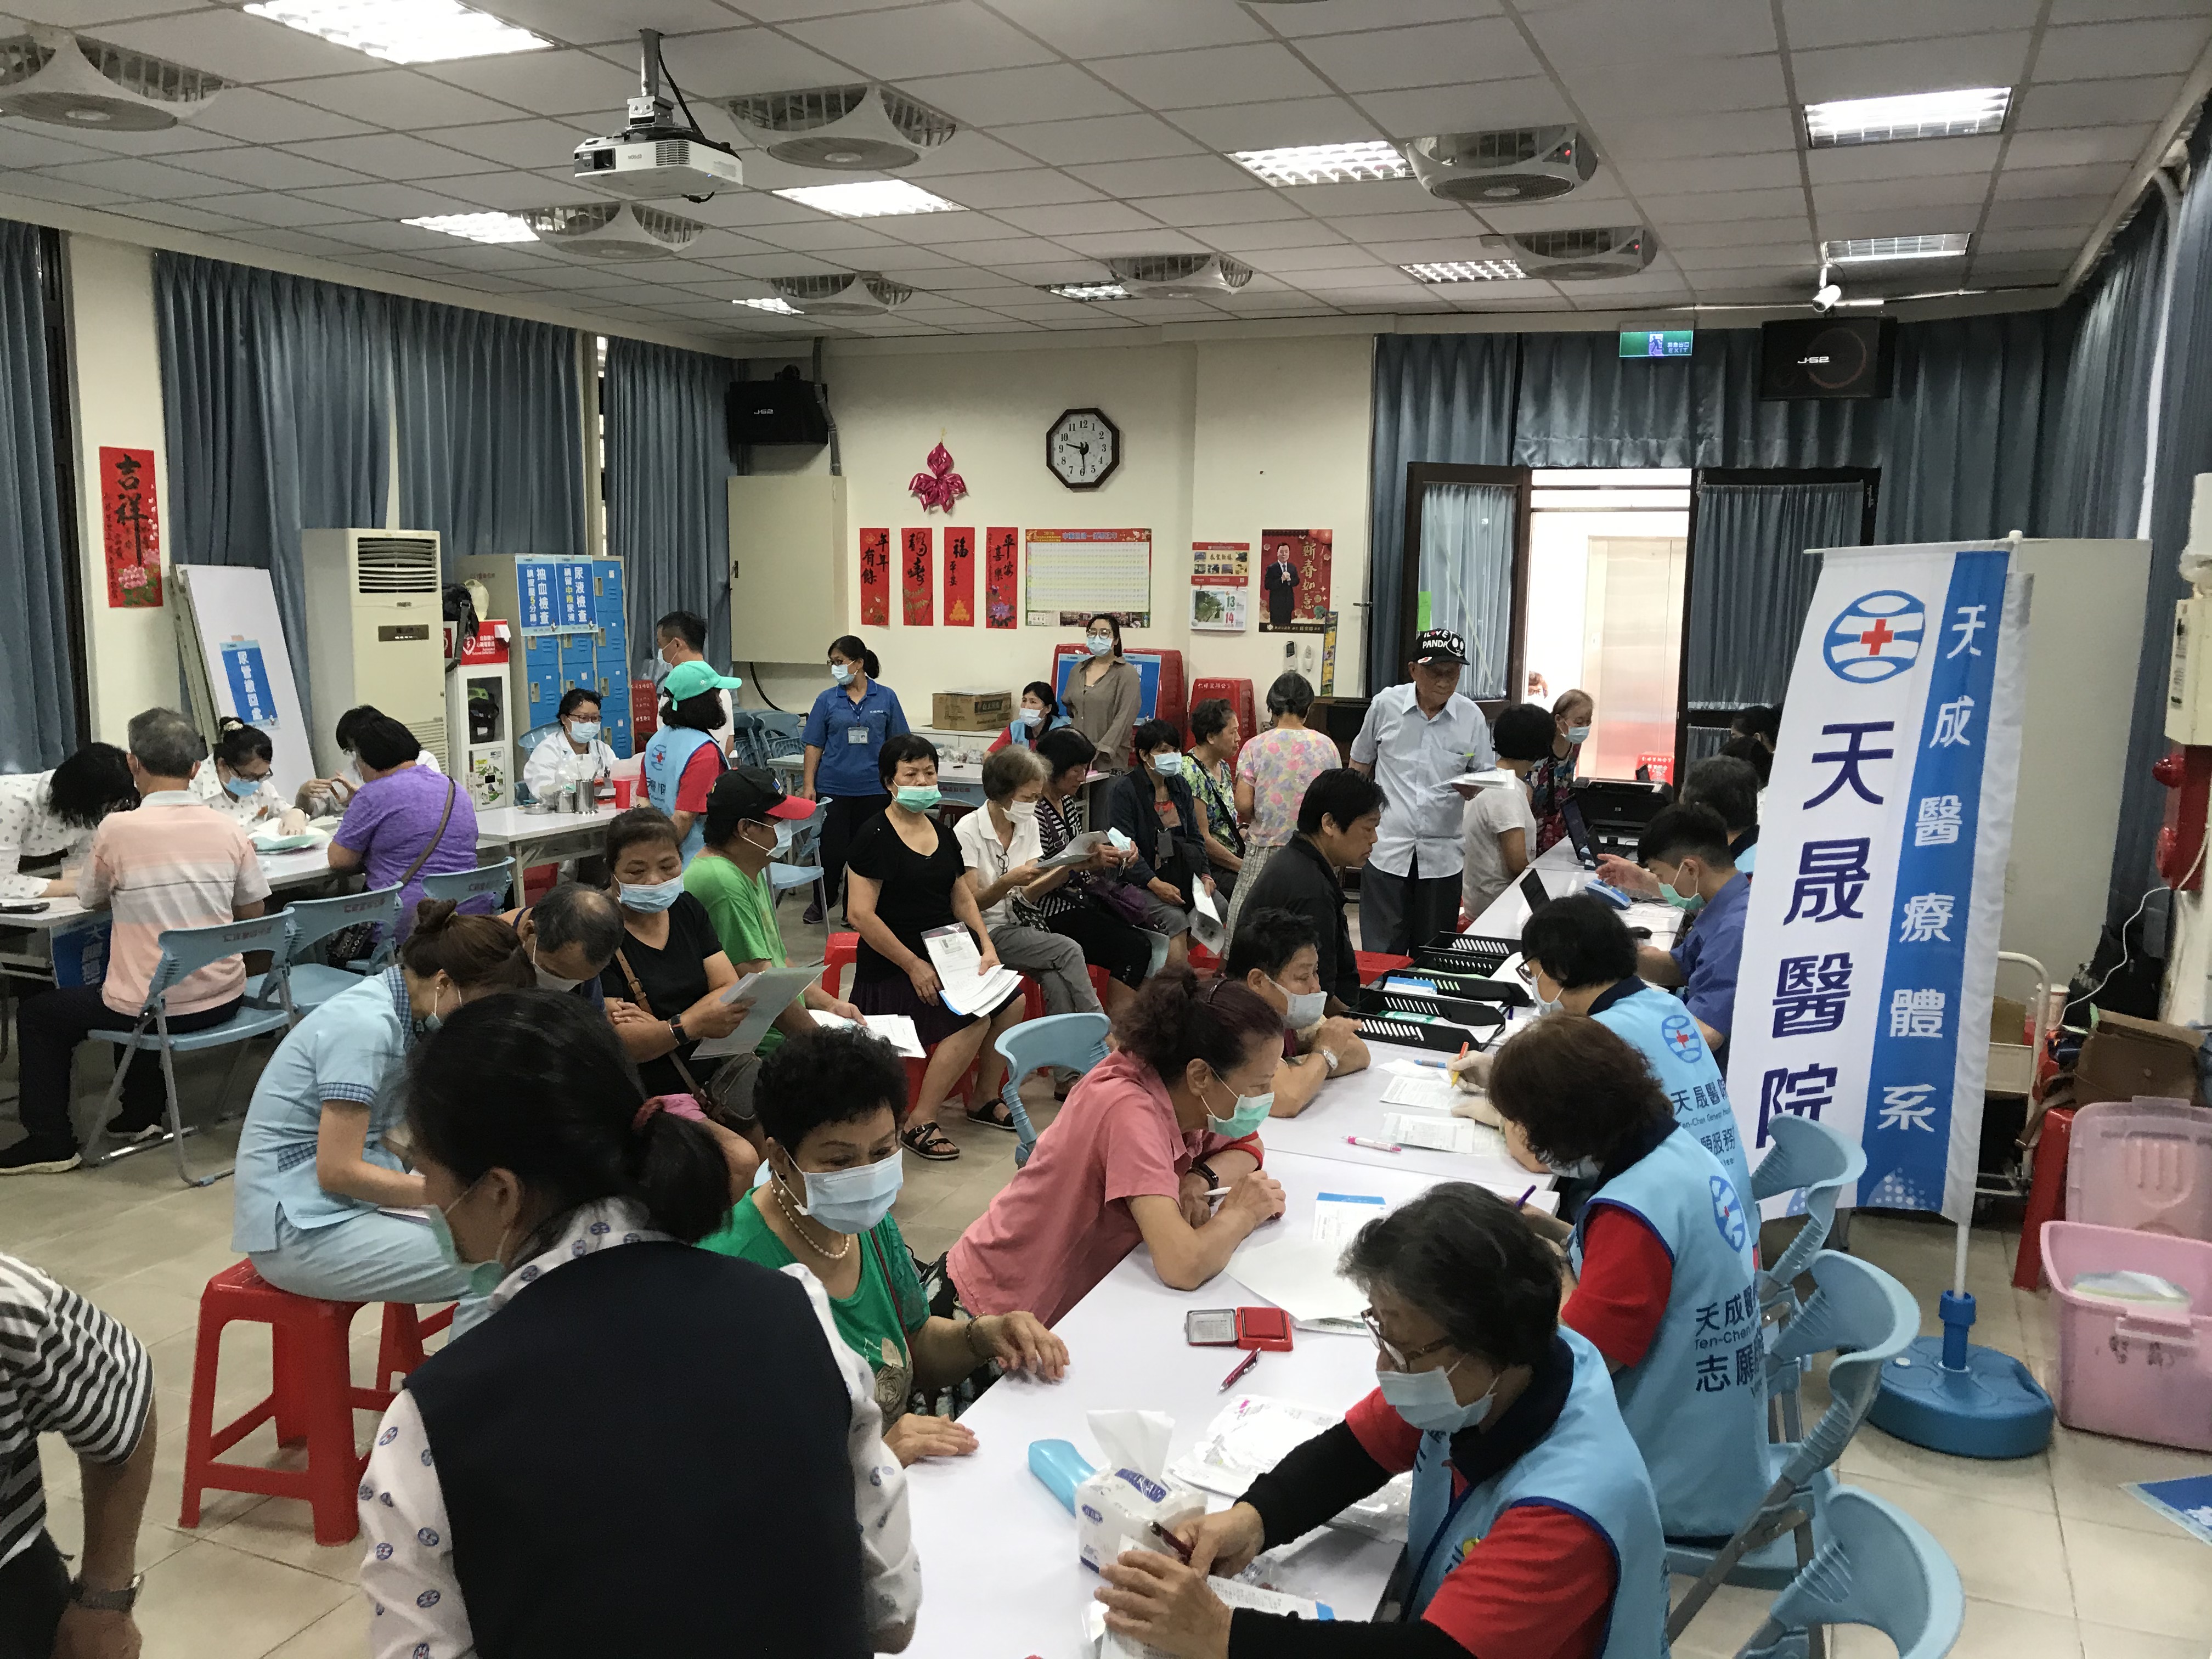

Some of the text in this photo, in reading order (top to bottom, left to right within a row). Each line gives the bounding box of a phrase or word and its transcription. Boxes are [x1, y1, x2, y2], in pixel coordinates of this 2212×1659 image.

[1060, 433, 1068, 441] 10
[1102, 444, 1106, 452] 3
[1061, 456, 1066, 465] 8
[1069, 466, 1073, 474] 7
[1080, 467, 1085, 476] 6
[115, 453, 149, 566] 吉祥
[875, 532, 889, 572] 年年
[953, 536, 969, 558] 福
[1002, 533, 1015, 577] 平安
[861, 546, 877, 585] 有餘
[1300, 541, 1317, 610] 新春如意
[537, 567, 549, 624] 抽血檢查
[574, 567, 587, 622] 尿液檢查
[1227, 596, 1235, 607] 13
[1226, 612, 1234, 624] 14
[1423, 640, 1448, 649] PANDA
[1877, 605, 1987, 1132] 天成醫療體系
[1756, 720, 1895, 1149] 天晟醫院
[1700, 1126, 1735, 1155] 願服務
